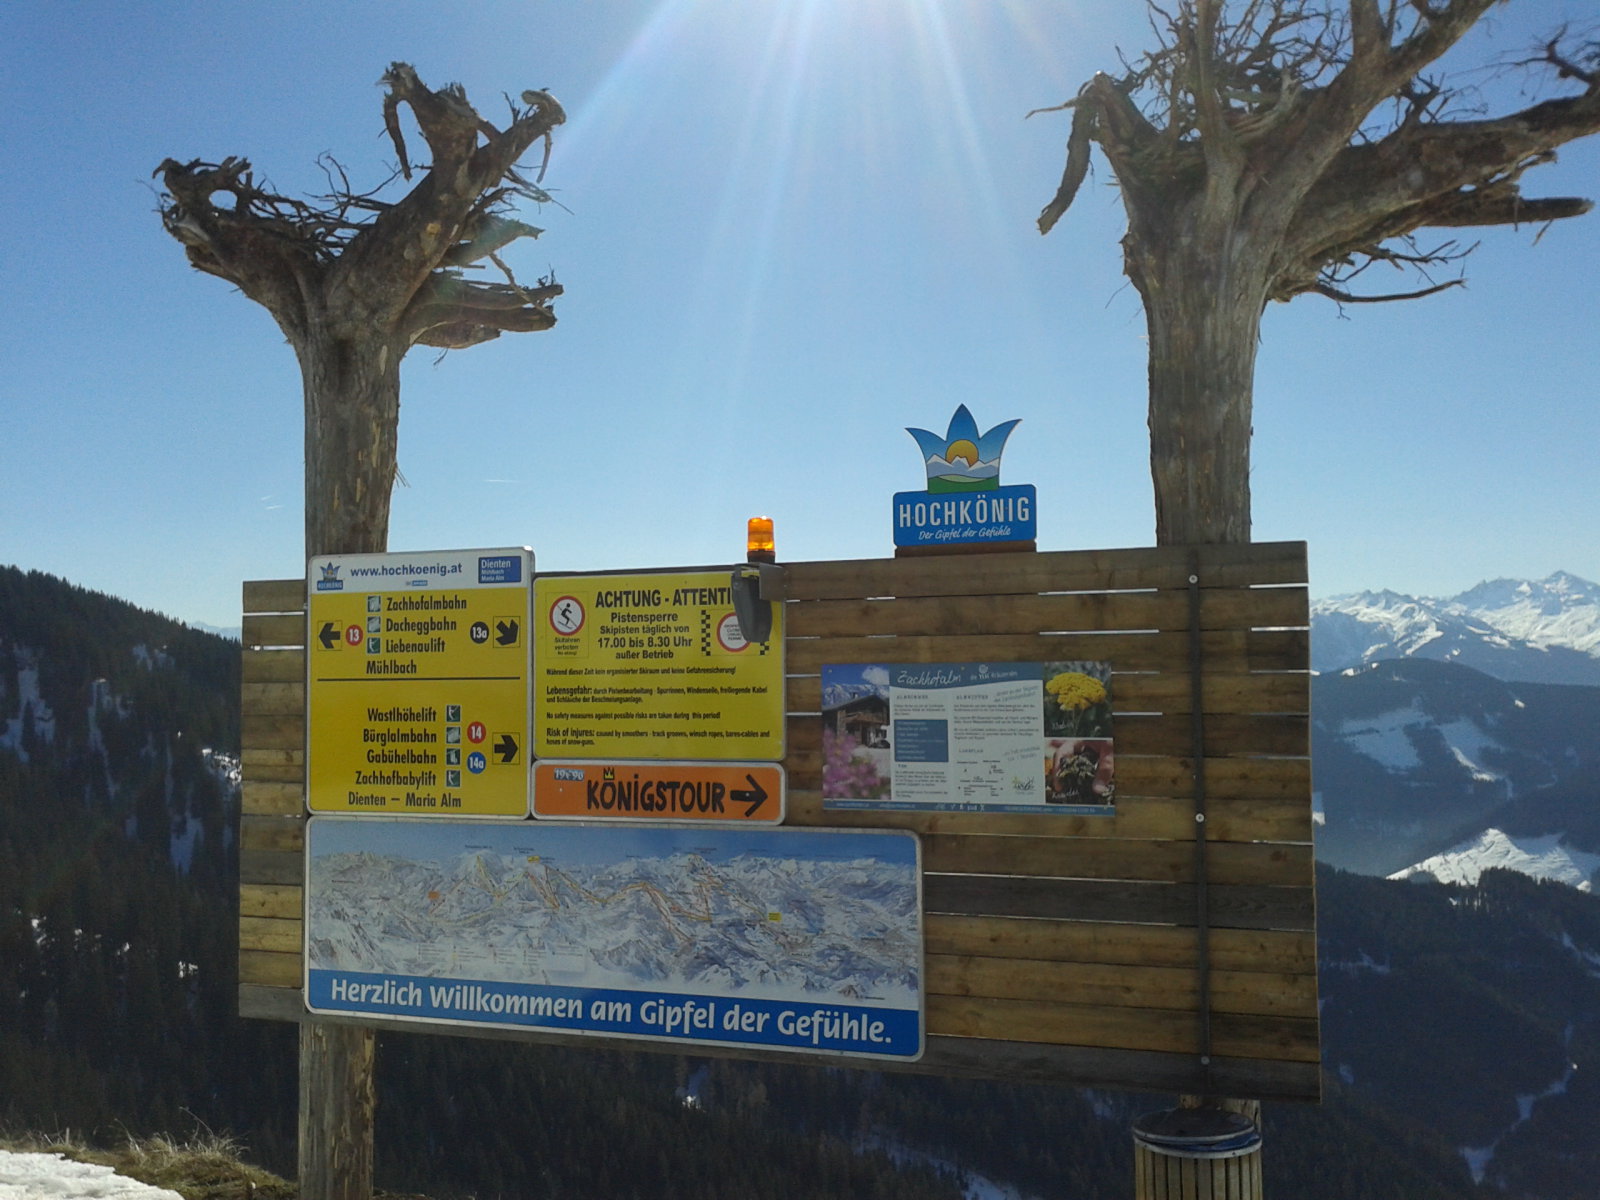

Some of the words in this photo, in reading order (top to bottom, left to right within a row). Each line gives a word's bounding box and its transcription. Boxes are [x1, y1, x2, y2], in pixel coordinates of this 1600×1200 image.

[900, 494, 1029, 528] HOCHKÖNIG
[919, 530, 933, 540] Der
[935, 528, 961, 541] Gipfel
[962, 527, 976, 538] der
[979, 525, 1011, 538] Gefühle
[350, 563, 462, 577] www.hochkoenig.at
[481, 559, 511, 568] Dienten
[386, 595, 467, 612] Zachhofalmbahn
[595, 589, 661, 608] ACHTUNG
[672, 587, 732, 606] ATTENTI
[611, 612, 678, 624] Pistensperre
[386, 618, 457, 635] Dacheggbahn
[472, 626, 488, 640] 13a
[600, 625, 640, 635] Skipisten
[642, 624, 672, 635] täglich
[349, 628, 360, 641] 13
[597, 637, 626, 648] 17.00
[629, 637, 644, 647] bis
[647, 637, 670, 647] 8.30
[673, 636, 693, 647] Uhr
[385, 638, 446, 653] Liebenaulift
[615, 651, 640, 659] außer
[642, 650, 674, 659] Betrieb
[366, 659, 417, 674] Mühlbach
[897, 670, 961, 686] Zachhofalm
[546, 685, 592, 696] Lebensgefahr:
[368, 707, 437, 722] Wastlhöhelift
[554, 712, 569, 720] safety
[595, 712, 612, 720] against
[613, 712, 634, 720] possible
[673, 712, 689, 720] during
[363, 728, 437, 746] Bürglalmbahn
[471, 727, 482, 740] 14
[546, 728, 560, 736] Risk
[562, 728, 569, 736] of
[571, 728, 594, 739] injures:
[615, 730, 620, 738] by
[367, 749, 437, 764] Gabühelbahn
[469, 757, 484, 769] 14a
[355, 771, 436, 789] Zachhofbabylift
[348, 792, 386, 806] Dienten
[405, 793, 437, 807] Maria
[440, 793, 462, 808] Alm
[331, 979, 422, 1007] Herzlich
[430, 985, 583, 1019] Willkommen
[590, 1000, 631, 1022] am
[640, 999, 715, 1034] Gipfel
[723, 1005, 770, 1033] der
[777, 1010, 892, 1044] Gefühle.
